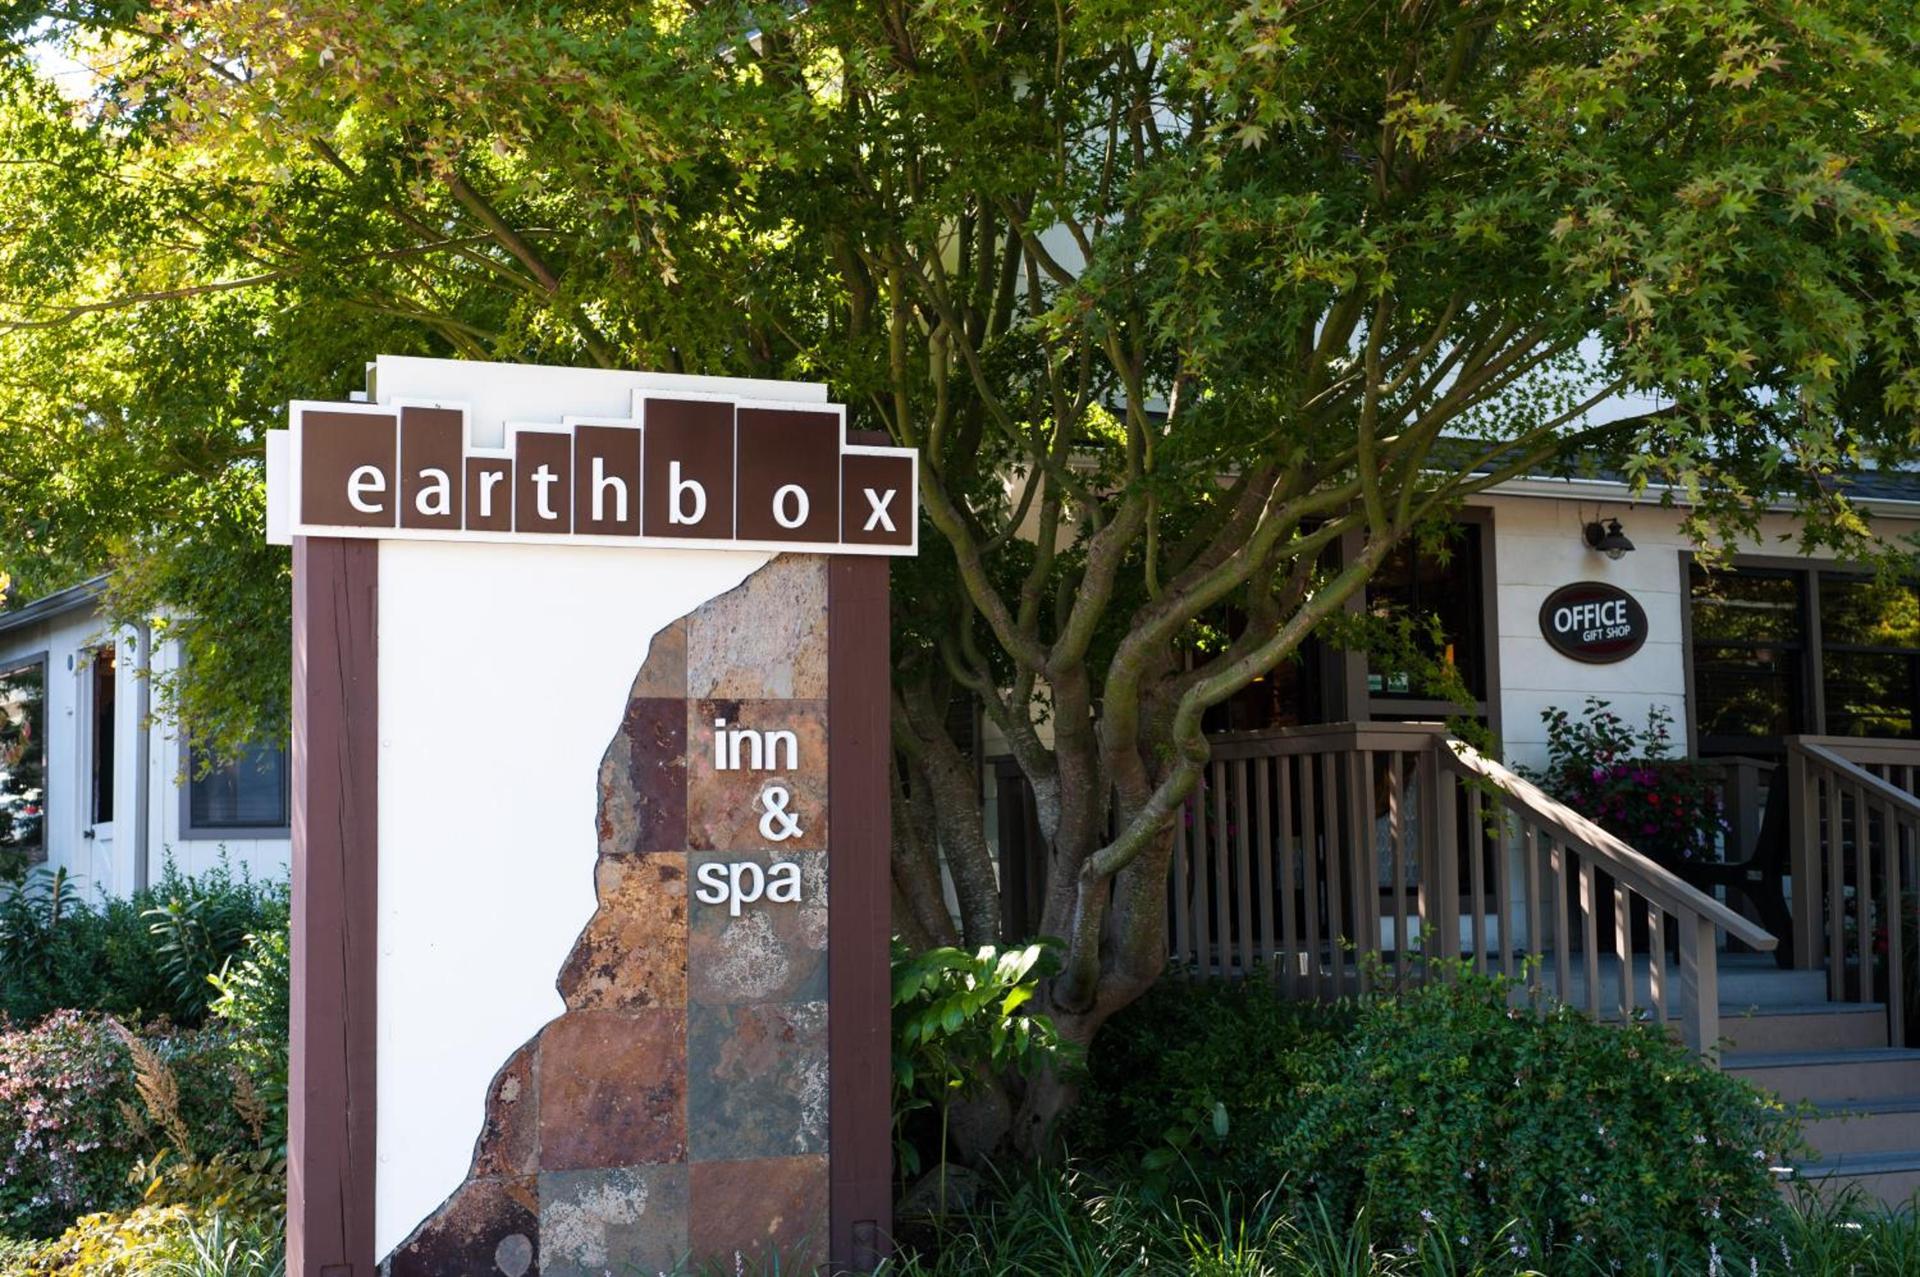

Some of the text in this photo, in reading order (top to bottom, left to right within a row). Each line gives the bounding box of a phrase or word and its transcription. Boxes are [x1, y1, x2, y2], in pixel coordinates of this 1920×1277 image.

[347, 457, 898, 532] earthbox
[1553, 599, 1628, 633] OFFICE
[1583, 625, 1631, 642] GIFT SHOP
[713, 718, 799, 770] inn
[758, 785, 803, 841] &
[695, 860, 802, 917] spa
